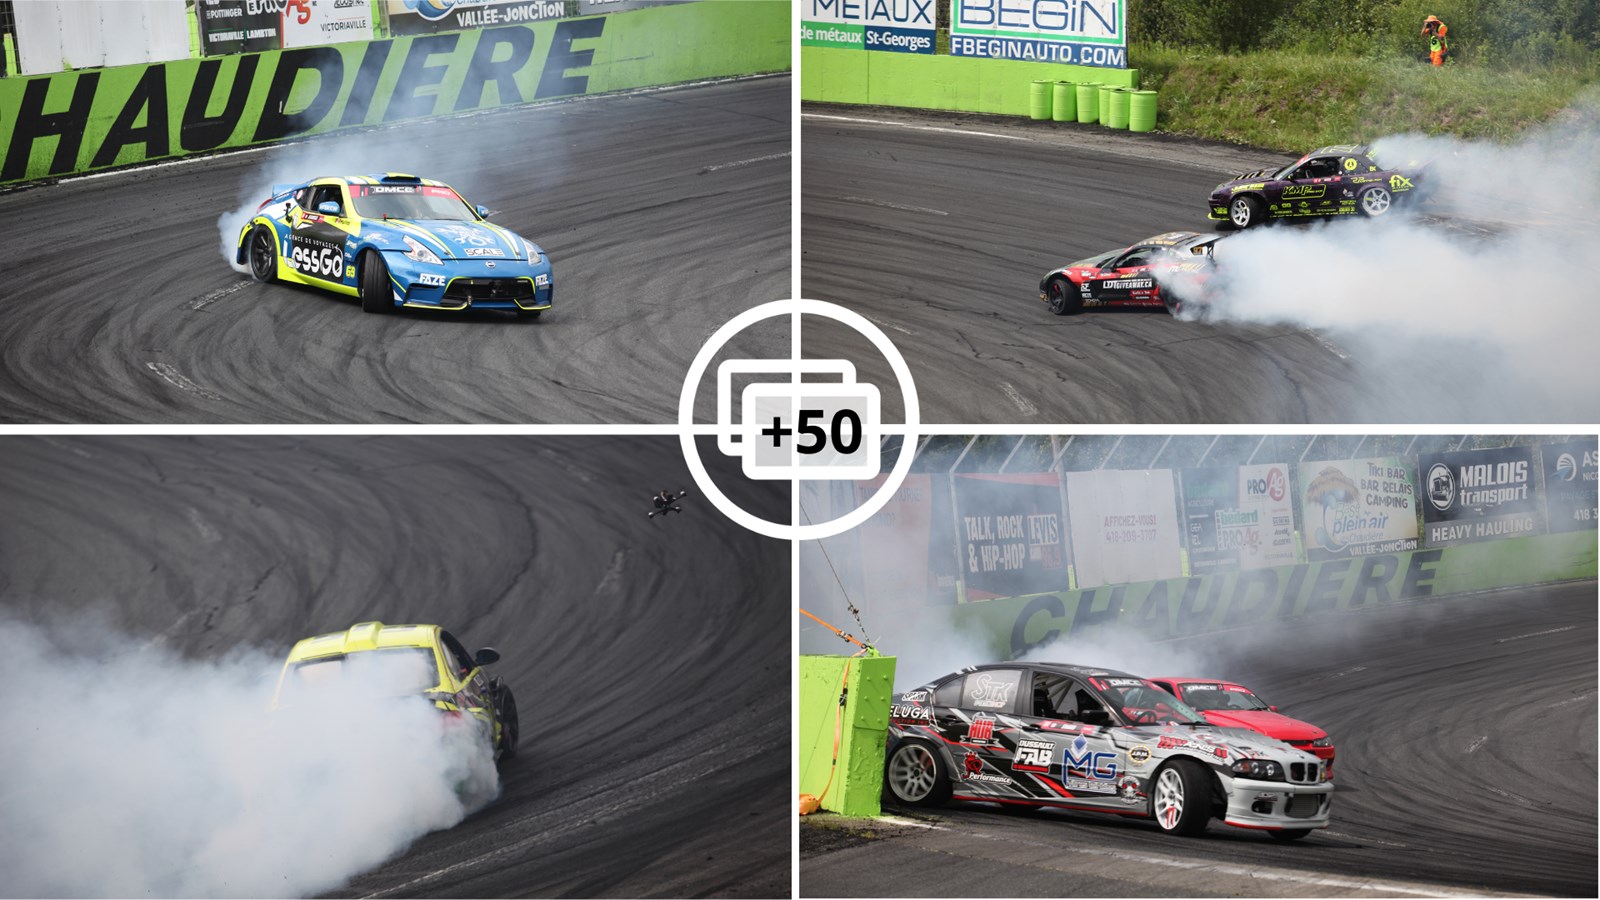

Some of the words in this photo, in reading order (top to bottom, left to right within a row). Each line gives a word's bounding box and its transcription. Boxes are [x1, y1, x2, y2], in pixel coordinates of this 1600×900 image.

[320, 20, 367, 31] VICTORIAVILLE
[815, 28, 863, 44] métaux
[866, 31, 931, 51] St-Georges
[305, 237, 312, 245] DE
[1387, 468, 1406, 480] BAR
[1459, 461, 1528, 488] MALOIS
[1360, 479, 1379, 492] BAR
[1382, 481, 1413, 495] RELAIS
[1459, 484, 1528, 508] transport
[1366, 493, 1409, 509] CAMPING
[1574, 509, 1590, 521] 418
[964, 516, 995, 545] TALK,
[996, 515, 1024, 540] ROCK
[1432, 523, 1473, 542] HEAVY
[1476, 518, 1534, 537] HAULING
[968, 543, 979, 573] &
[980, 543, 1026, 572] HIP-HOP
[1014, 747, 1052, 767] FAB
[1062, 748, 1117, 785] MG
[969, 771, 1012, 785] Performance
